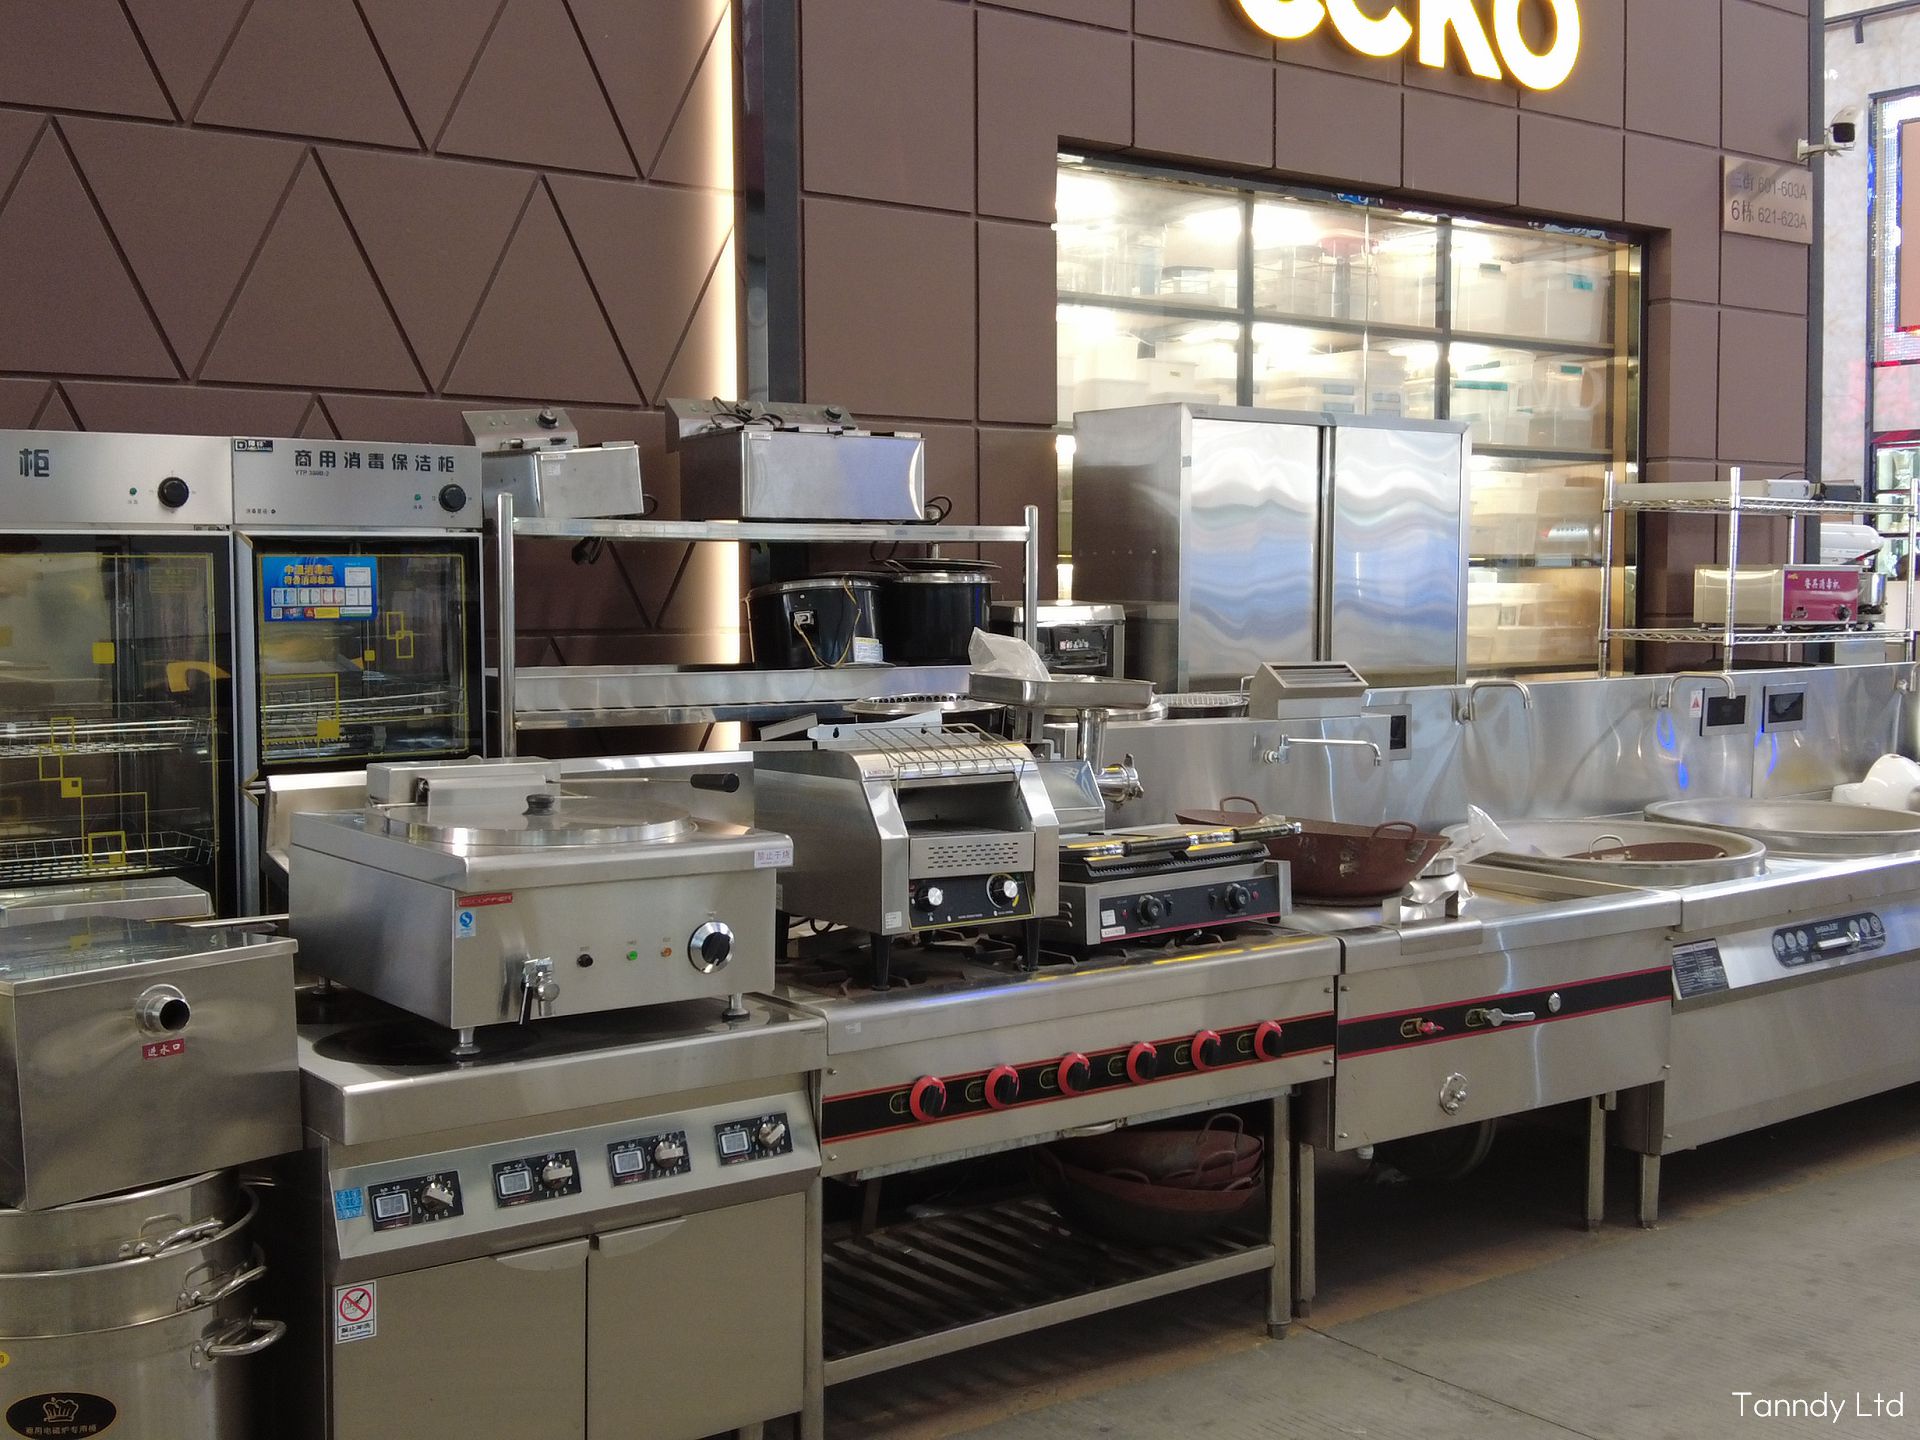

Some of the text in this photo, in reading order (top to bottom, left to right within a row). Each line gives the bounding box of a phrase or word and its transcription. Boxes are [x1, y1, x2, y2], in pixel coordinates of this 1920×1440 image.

[1758, 207, 1808, 230] 621-623A
[19, 448, 50, 477] 柜
[294, 449, 455, 473] 商用消毒保洁柜
[147, 1043, 181, 1057] 进水口
